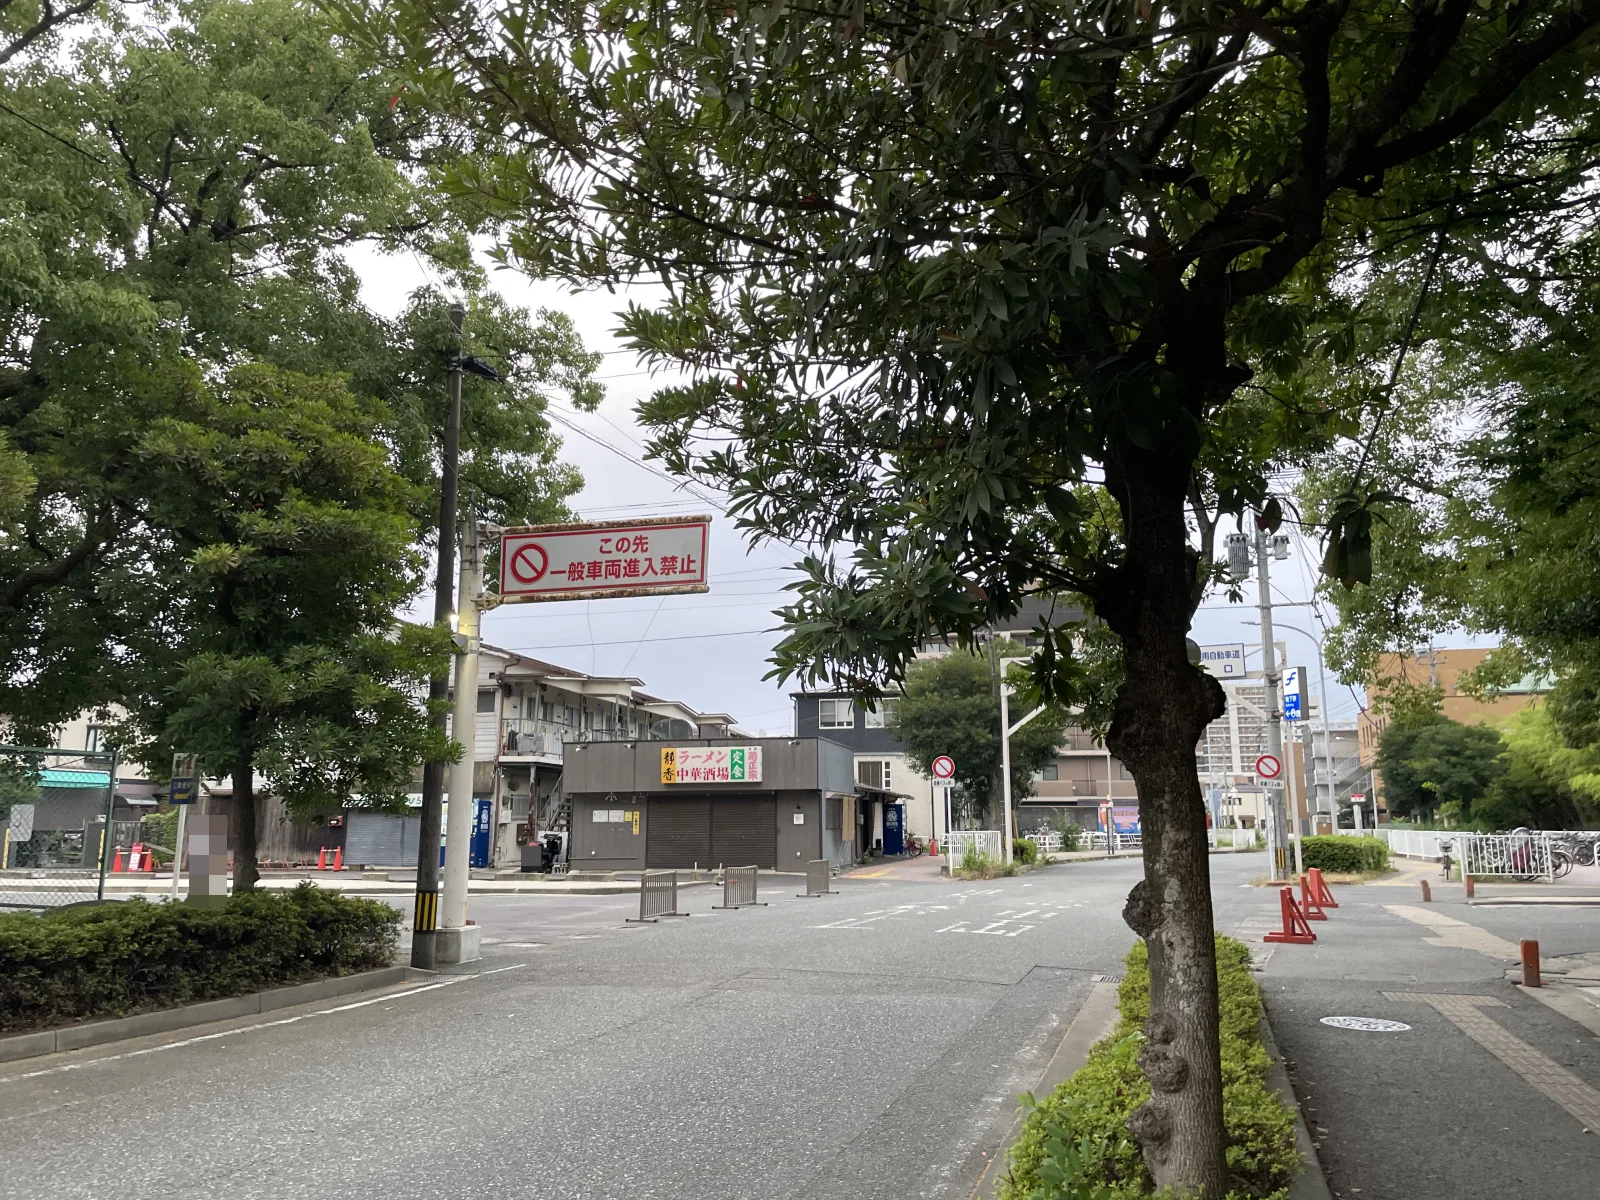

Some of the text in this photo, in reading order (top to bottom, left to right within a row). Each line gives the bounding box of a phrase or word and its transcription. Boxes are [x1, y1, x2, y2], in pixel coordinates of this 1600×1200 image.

[599, 535, 649, 554] この先
[550, 554, 697, 582] 一般車両進入禁止
[678, 750, 728, 764] ラーメン
[732, 750, 743, 778] 定食
[748, 751, 758, 780] 菊正宗
[676, 766, 730, 781] 中華酒場
